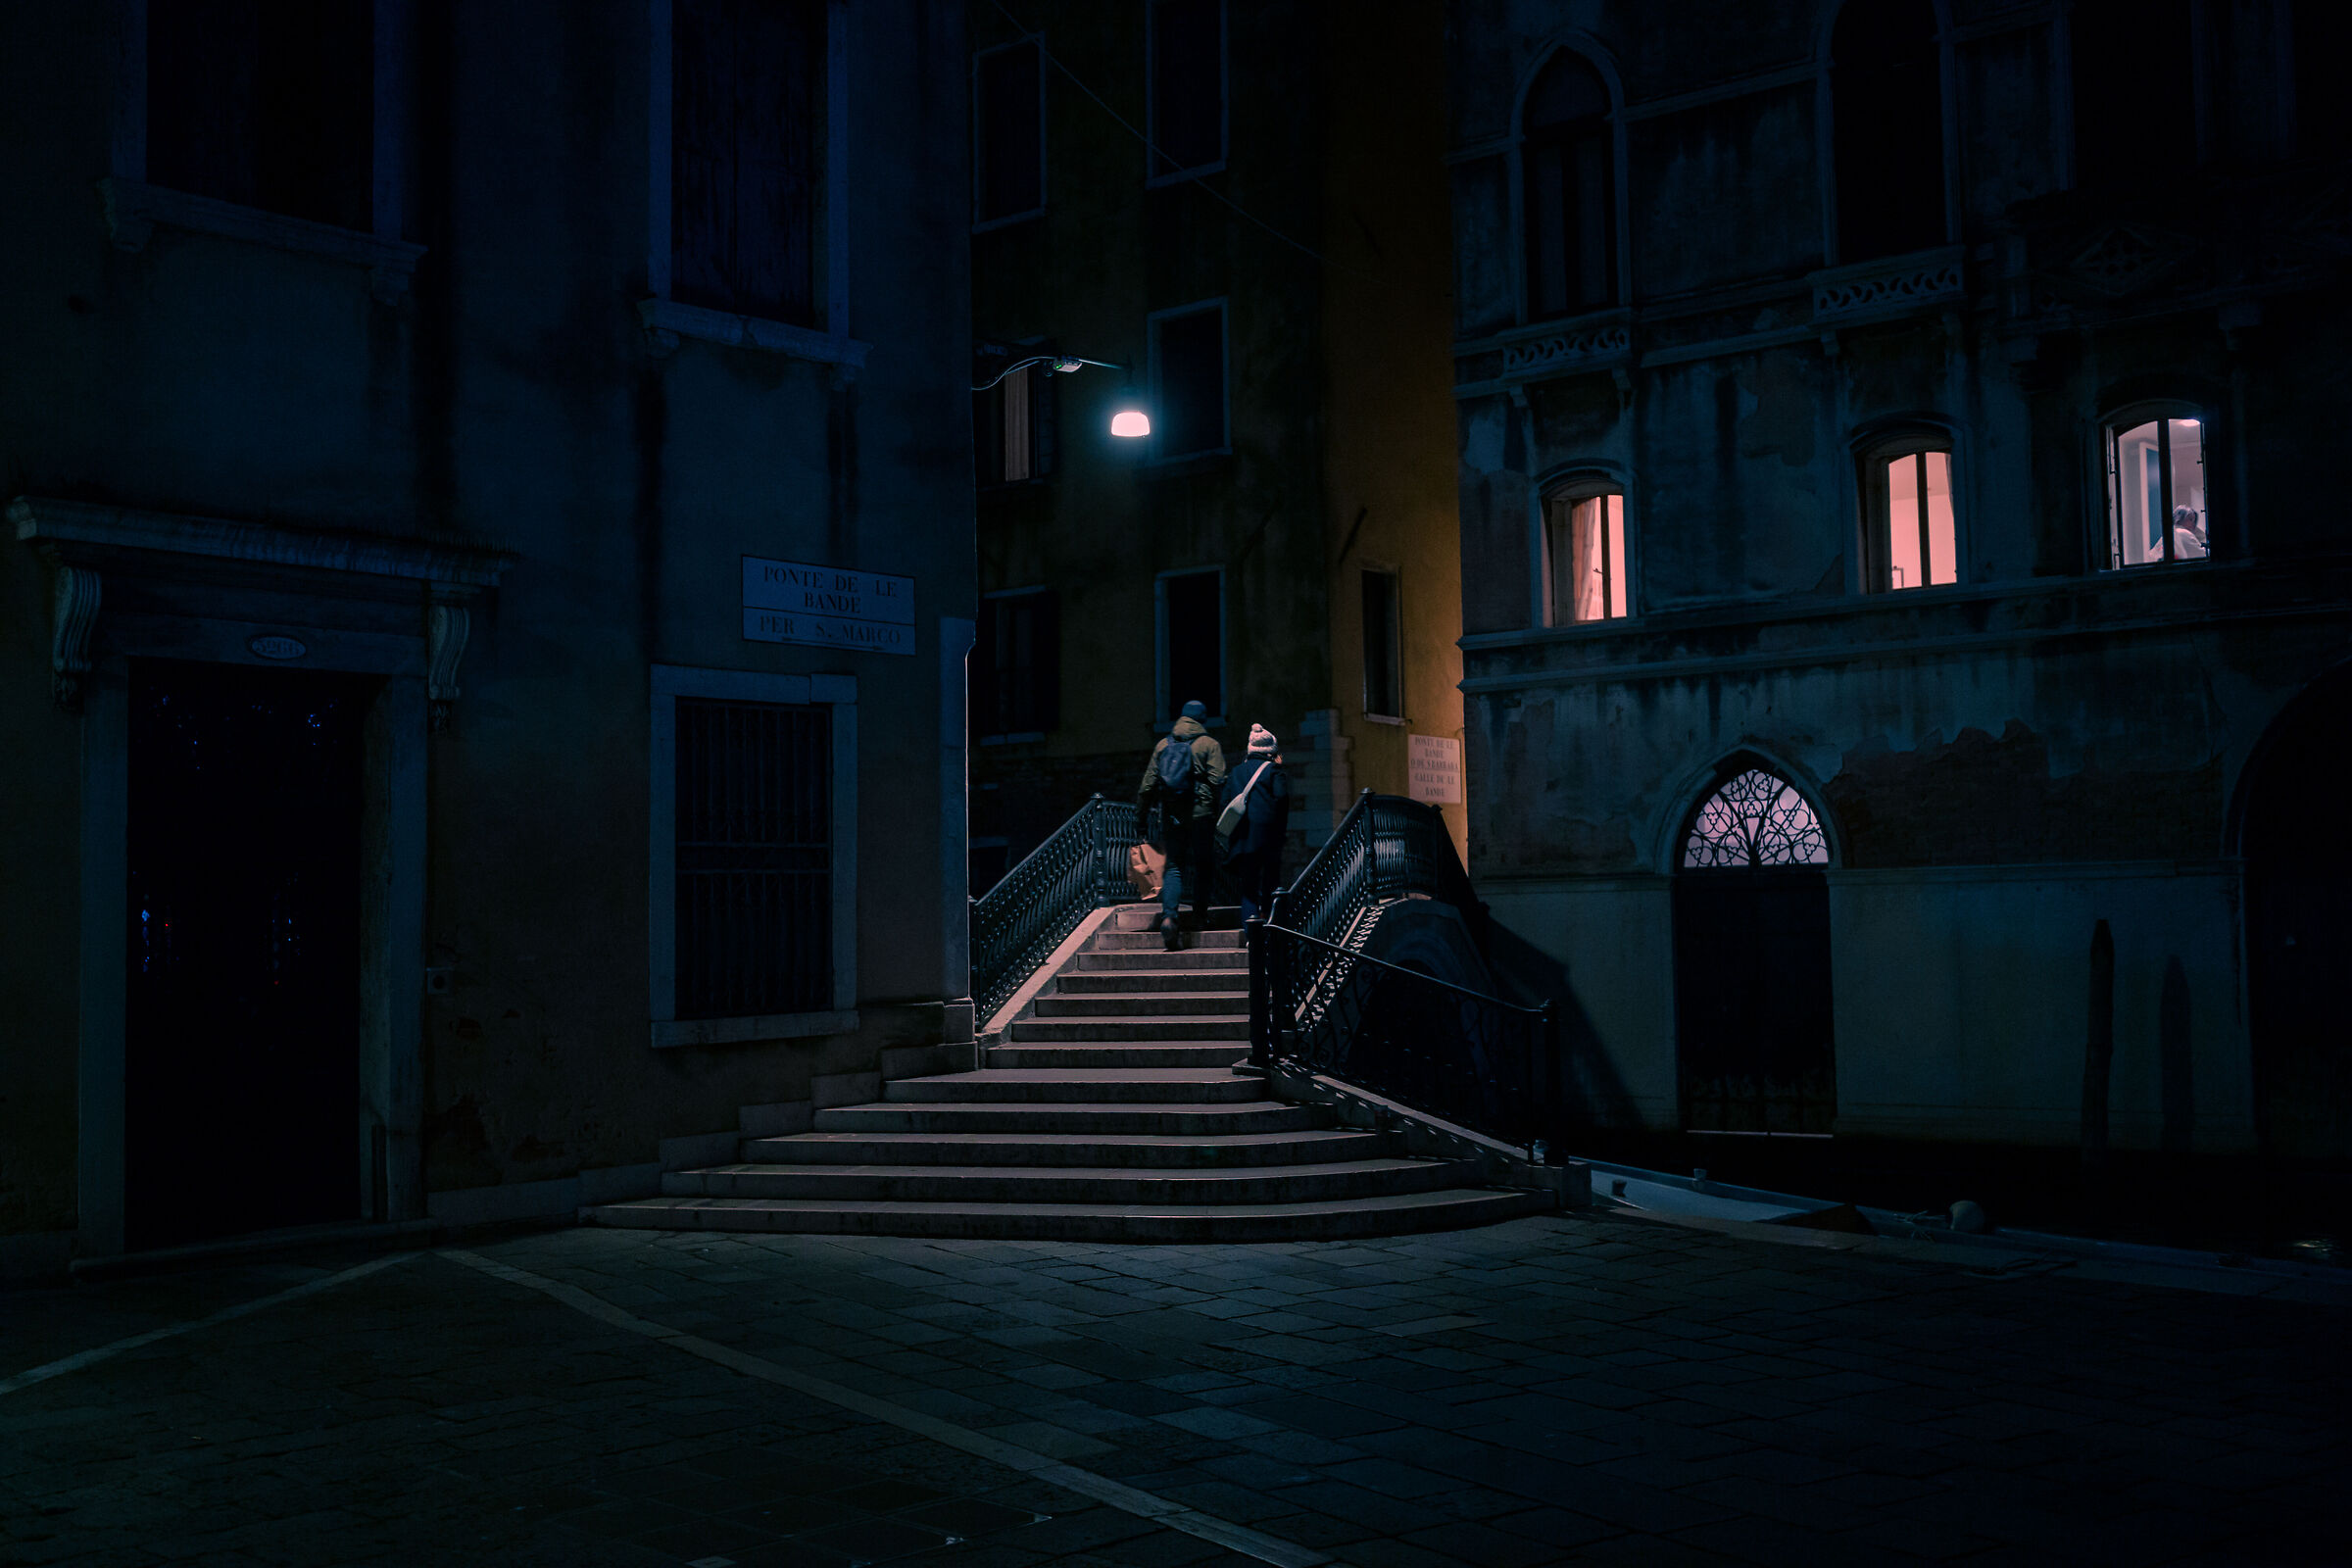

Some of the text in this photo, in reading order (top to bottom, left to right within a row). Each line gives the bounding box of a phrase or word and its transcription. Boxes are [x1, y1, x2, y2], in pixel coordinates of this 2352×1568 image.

[763, 565, 898, 598] PONTE DE LE
[804, 592, 861, 613] BANDE
[760, 615, 902, 643] PER S. MARCO
